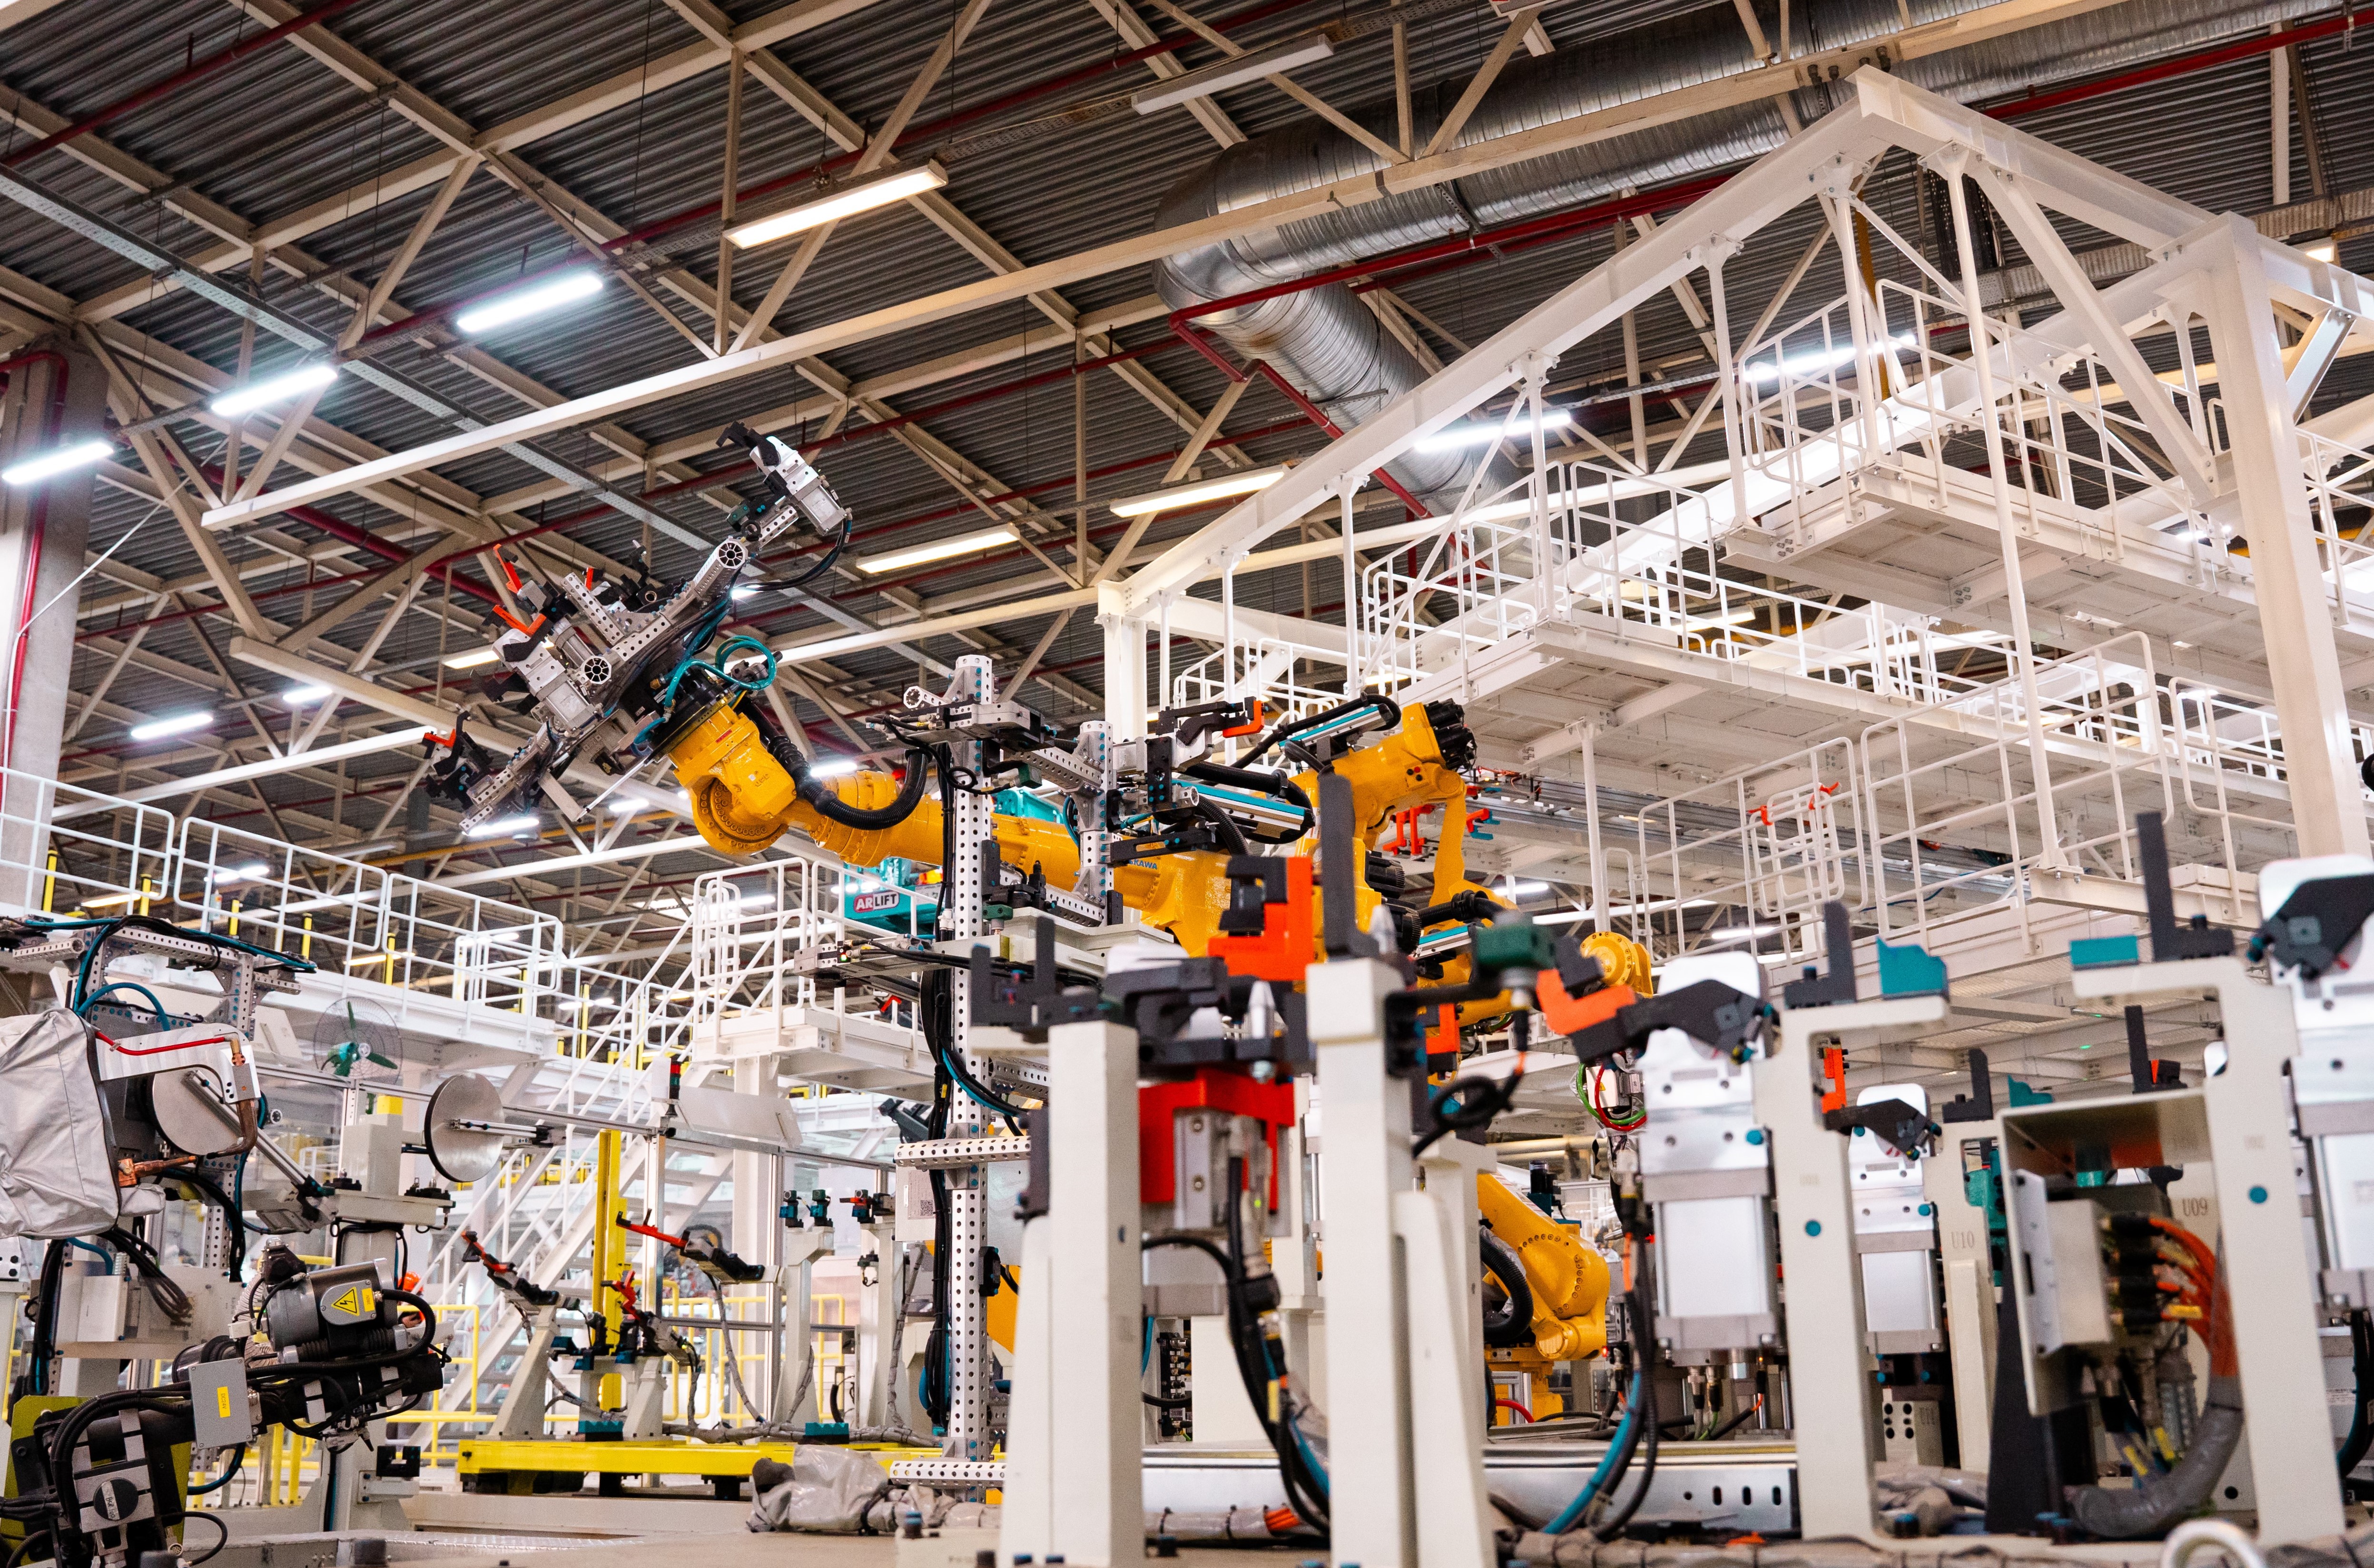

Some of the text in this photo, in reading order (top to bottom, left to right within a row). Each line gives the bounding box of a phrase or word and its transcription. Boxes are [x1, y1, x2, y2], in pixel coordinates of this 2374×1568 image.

[856, 894, 896, 910] ARLIFT
[2182, 1197, 2208, 1216] U09
[1951, 1230, 1975, 1249] U10
